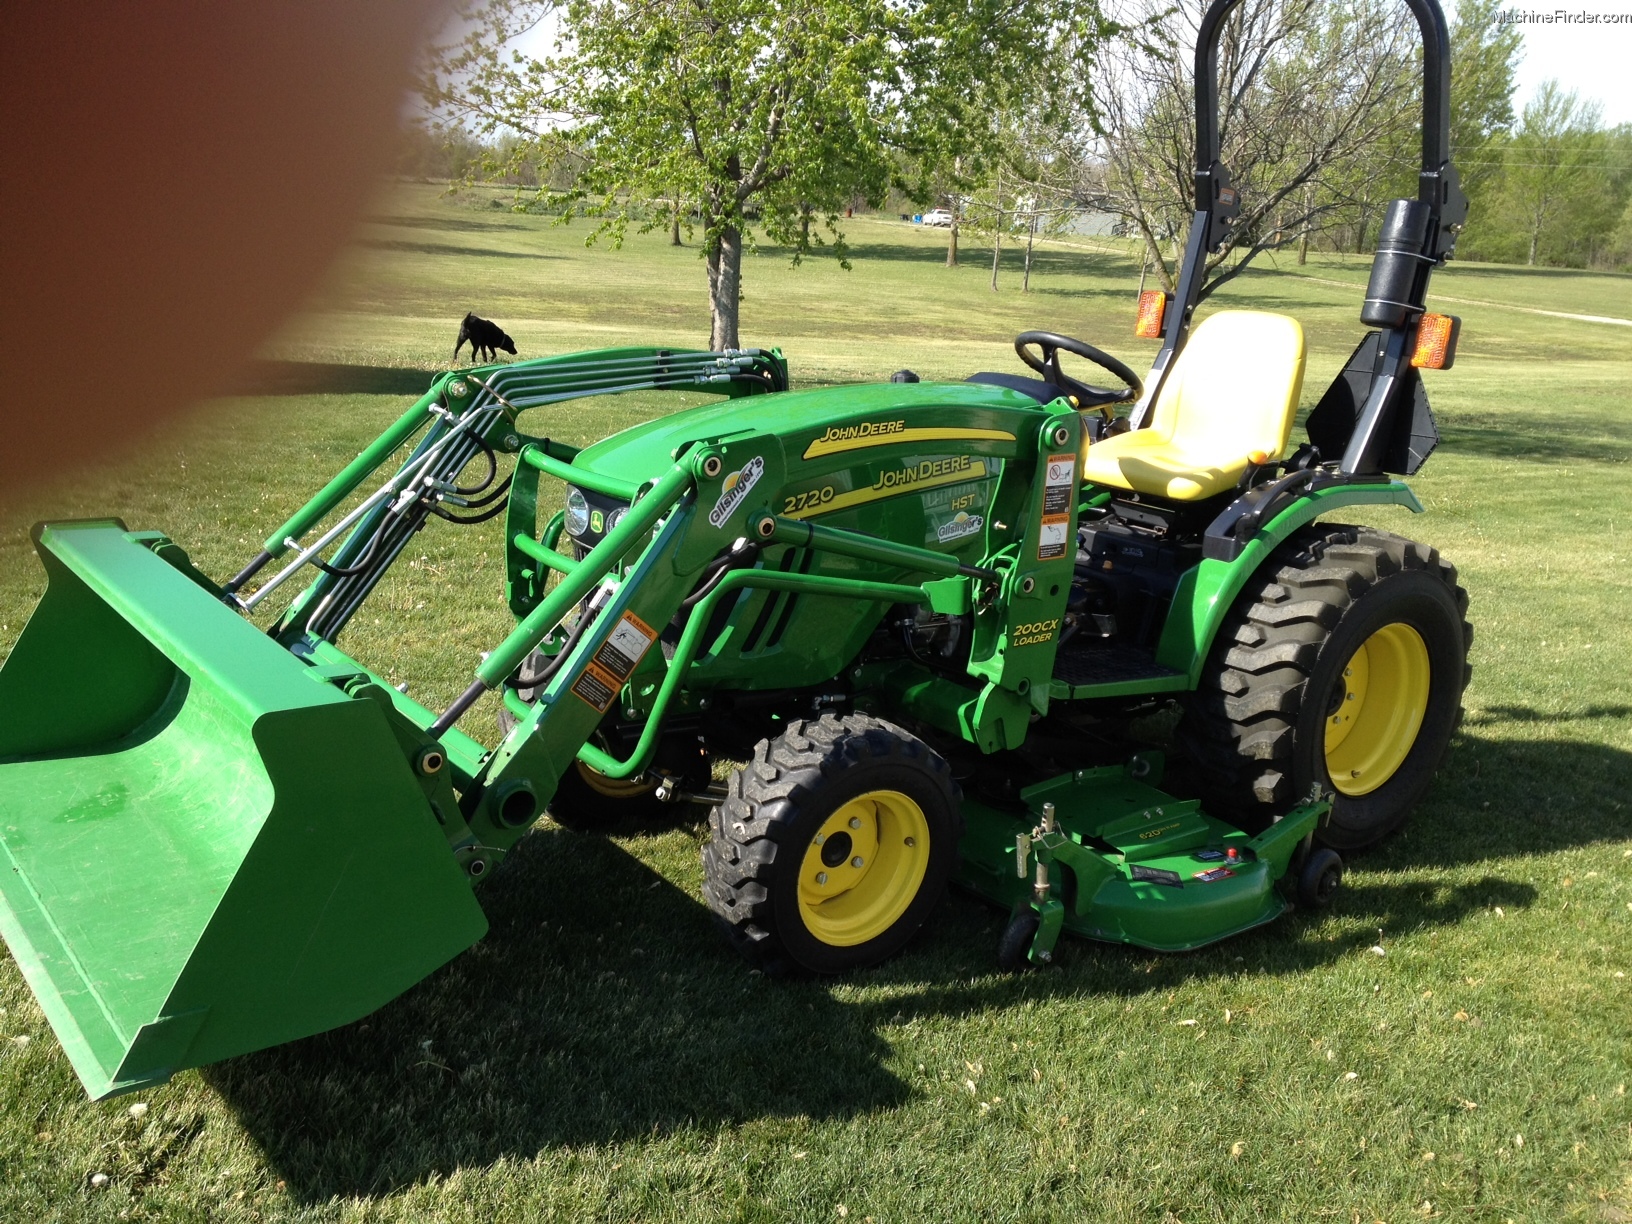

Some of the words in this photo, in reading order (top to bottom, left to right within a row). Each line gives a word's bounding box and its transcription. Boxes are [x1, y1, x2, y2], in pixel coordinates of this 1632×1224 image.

[820, 426, 859, 442] JOHN
[858, 420, 905, 437] DEERE
[873, 466, 918, 490] JOHN
[918, 455, 971, 479] DEERE
[710, 457, 763, 524] Gilsinger's
[783, 486, 834, 514] 2720
[952, 493, 976, 511] HST
[938, 516, 983, 538] Gilsinger's
[632, 619, 653, 638] WARNING
[1013, 619, 1059, 636] 200CX
[1013, 633, 1053, 647] LOADER
[595, 670, 617, 690] WARNING
